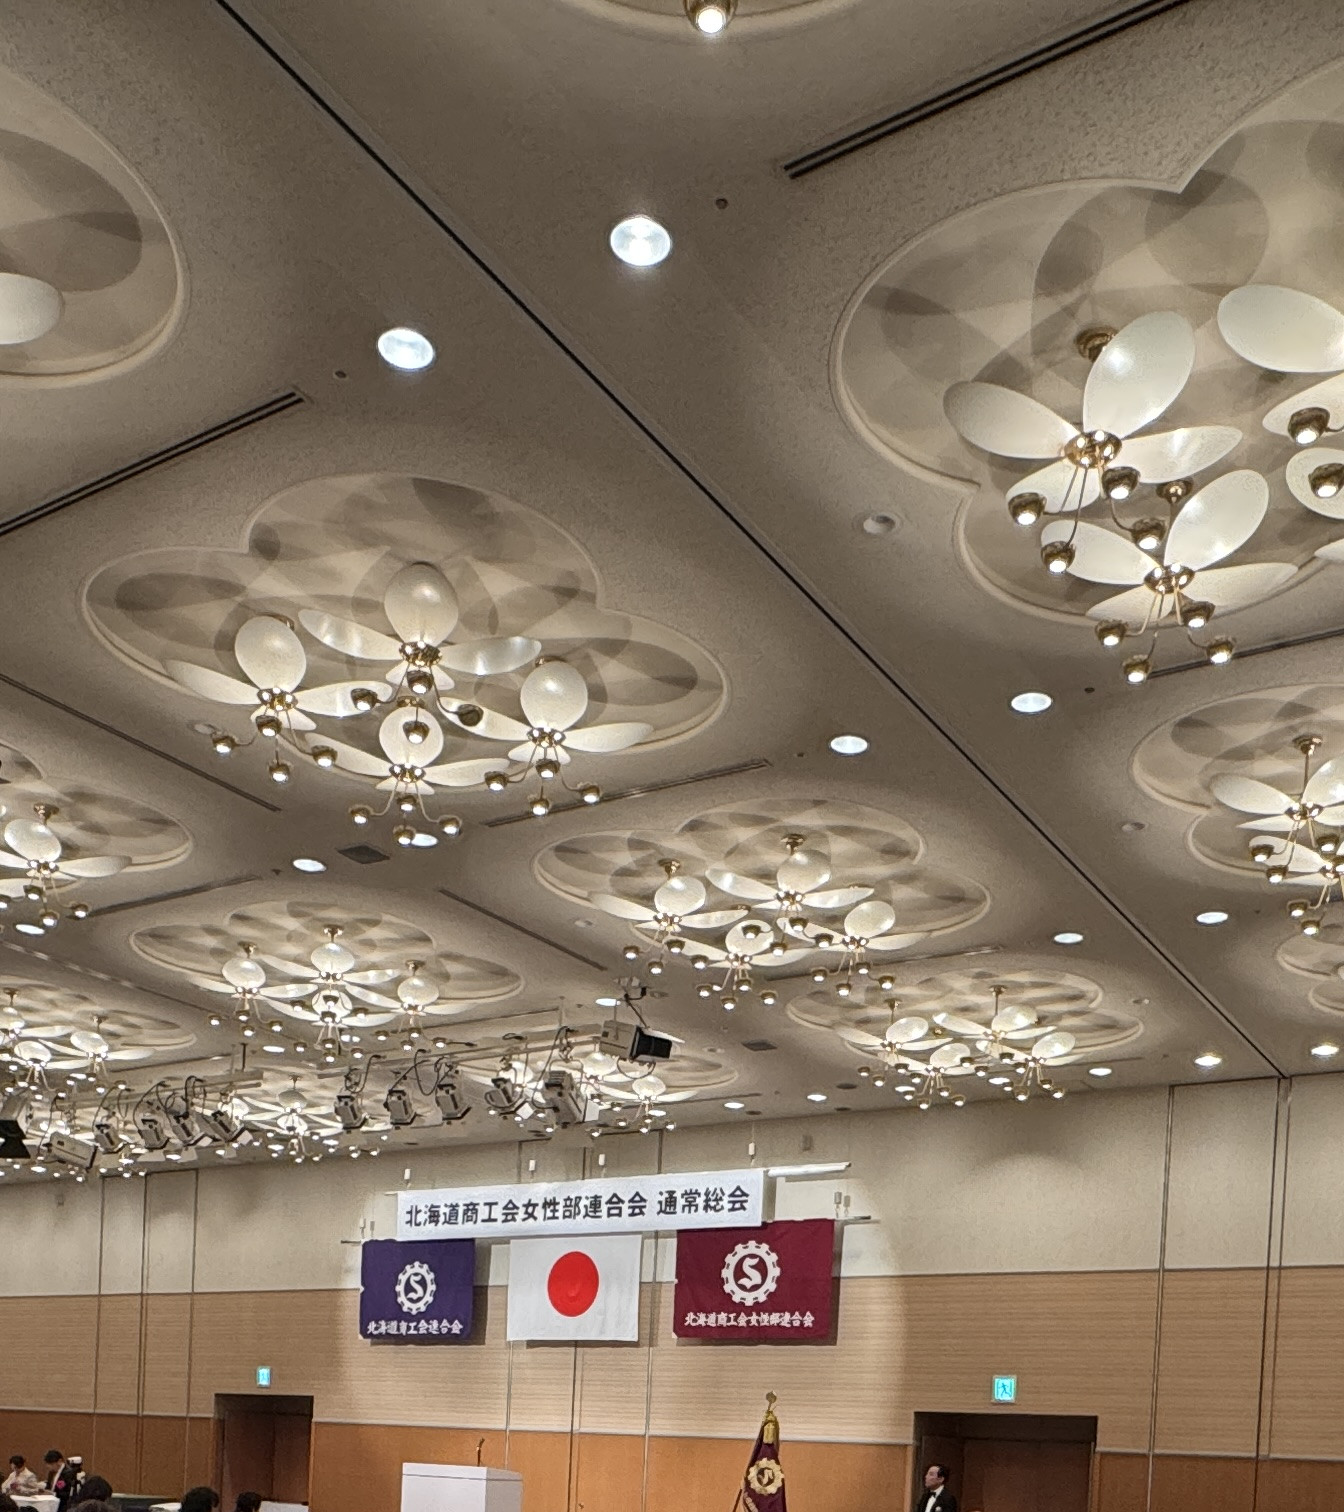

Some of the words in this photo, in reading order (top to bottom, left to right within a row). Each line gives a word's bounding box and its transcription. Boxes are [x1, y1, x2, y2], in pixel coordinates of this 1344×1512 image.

[405, 1191, 648, 1228] 北海道商工会女性部連合会
[657, 1184, 750, 1216] 通常総会
[366, 1318, 464, 1336] 北海道商工会連合会
[684, 1310, 815, 1328] 北海道商工会女性部連合会
